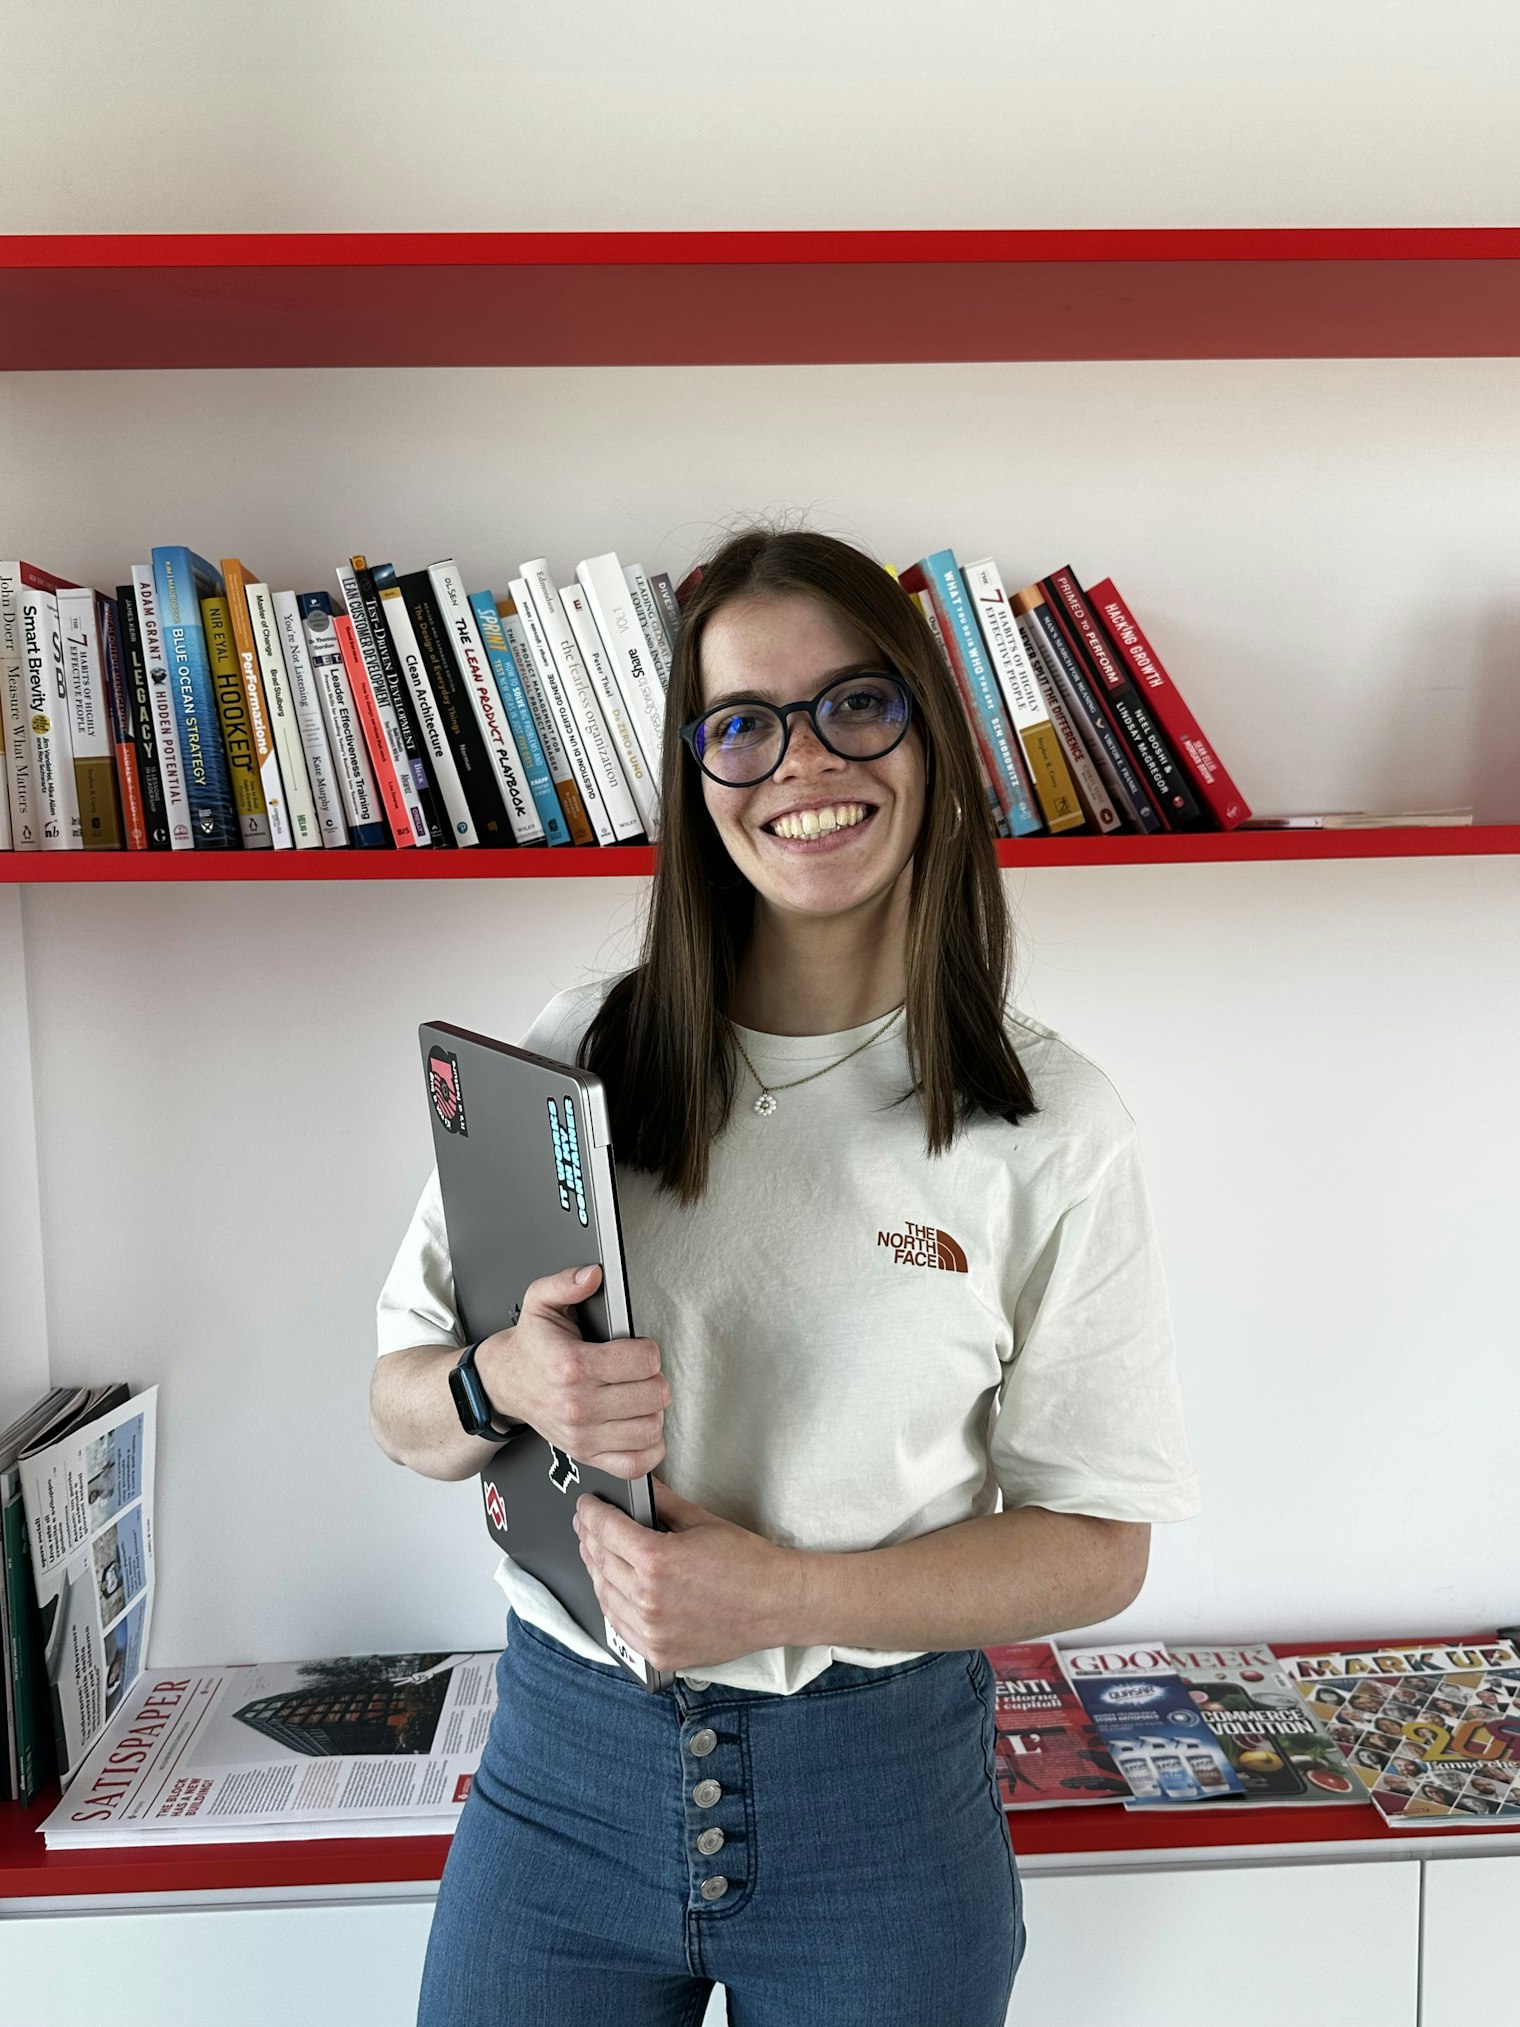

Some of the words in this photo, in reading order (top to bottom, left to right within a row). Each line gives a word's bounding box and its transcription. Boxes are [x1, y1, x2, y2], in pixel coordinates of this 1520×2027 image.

[0, 576, 13, 607] John
[342, 577, 359, 600] LEAN
[444, 577, 458, 606] OLSEN
[536, 571, 554, 613] Edmondson
[980, 571, 988, 584] THE
[125, 599, 133, 621] JAMES
[140, 582, 154, 616] ADAM
[414, 604, 423, 621] The
[635, 576, 655, 619] LEADING
[979, 588, 1004, 609] 7
[3, 613, 15, 650] Doerr
[23, 606, 40, 653] Smart
[128, 623, 136, 642] KERR
[209, 608, 222, 628] NIR
[256, 595, 265, 619] Master
[262, 628, 272, 657] Change
[283, 613, 295, 642] You're
[349, 601, 373, 647] CUSTOMER
[477, 609, 506, 650] SPRINT
[1058, 577, 1084, 618] PRIMED
[1086, 632, 1118, 682] PERFORM
[67, 633, 87, 648] 7
[145, 620, 161, 660] GRANT
[172, 628, 187, 662] BLUE
[213, 632, 228, 662] EYAL
[290, 645, 301, 663] Not
[419, 622, 433, 652] Design
[944, 571, 962, 604] WHAT
[956, 606, 967, 624] YOU
[968, 647, 984, 674] WHO
[979, 675, 989, 692] YOU
[984, 694, 994, 709] ARE
[1105, 603, 1137, 644] HACKING
[1130, 645, 1162, 687] GROWTH
[70, 646, 81, 696] EFFECTIVE
[80, 651, 89, 685] HABITS
[429, 653, 438, 663] of
[494, 659, 504, 677] TEST
[505, 662, 515, 677] HOW
[592, 652, 603, 674] Peter
[601, 675, 613, 697] Thiel
[985, 606, 1011, 664] EFFECTIVE
[1006, 669, 1026, 710] PEOPLE
[998, 611, 1017, 652] HABITS
[1013, 654, 1023, 667] OF
[1018, 670, 1038, 711] HIGHLY
[8, 666, 20, 719] Measure
[28, 658, 45, 711] Brevity
[84, 688, 91, 700] OF
[178, 666, 195, 713] OCEAN
[270, 669, 280, 686] Brad
[294, 665, 308, 707] Listening
[363, 648, 390, 707] DEVELOPMENT
[433, 665, 450, 704] Everyday
[499, 677, 509, 693] NEW
[510, 677, 518, 687] TO
[547, 673, 563, 706] GENERE
[1015, 627, 1036, 659] NEVER
[1031, 659, 1050, 685] SPLIT
[1044, 686, 1058, 705] THE
[1052, 706, 1084, 761] DIFFERENCE
[156, 691, 171, 734] HIDDEN
[242, 652, 267, 754] PerFormazione
[273, 686, 284, 717] Stulberg
[406, 654, 421, 686] Clean
[416, 689, 443, 757] Architecture
[504, 692, 515, 711] IDEAS
[507, 628, 516, 644] THE
[512, 646, 532, 694] UNOFFICIAL
[529, 696, 545, 730] PROJECT
[542, 733, 558, 771] MANAGER
[512, 686, 525, 708] SOLVE
[519, 643, 535, 677] PROJECT
[532, 680, 554, 734] MANAGEMENT
[550, 736, 560, 753] FOR
[519, 708, 529, 720] BIG
[560, 640, 575, 660] the
[568, 663, 590, 708] fearless
[585, 711, 618, 787] organization
[75, 699, 85, 732] PEOPLE
[85, 702, 95, 736] HIGHLY
[218, 674, 251, 768] HOOKED
[447, 705, 460, 734] Things
[455, 618, 471, 644] THE
[464, 648, 483, 682] LEAN
[477, 687, 504, 744] PRODUCT
[497, 749, 525, 816] PLAYBOOK
[509, 711, 518, 719] IN
[512, 720, 523, 735] JUST
[559, 707, 573, 734] CERTO
[13, 725, 26, 759] What
[186, 717, 205, 786] STRATEGY
[330, 668, 344, 704] Leader
[339, 708, 360, 777] Effectiveness
[355, 778, 370, 820] Training
[517, 735, 528, 752] FIVE
[523, 720, 538, 752] PROBLEMS
[568, 734, 577, 744] UN
[571, 743, 579, 752] DI
[991, 717, 1003, 737] BEN
[998, 739, 1019, 786] HOROWITZ
[1116, 702, 1141, 740] LINDSAY
[1138, 742, 1168, 793] McGREGOR
[1134, 709, 1151, 734] NEEL
[1148, 734, 1167, 764] DOSHI
[1163, 765, 1172, 773] &
[163, 739, 181, 804] POTENTIAL
[312, 756, 323, 775] Kate
[522, 751, 533, 769] DAYS
[533, 753, 543, 766] AND
[16, 765, 29, 813] Matters
[316, 778, 329, 811] Murphy
[576, 757, 596, 799] QUESTIONI
[547, 1100, 564, 1181] WORKS
[559, 1128, 572, 1162] MY
[564, 1098, 588, 1226] CONTAINER
[564, 1164, 576, 1189] IN
[559, 1184, 570, 1210] IT
[877, 1231, 936, 1254] NORTH
[905, 1221, 935, 1241] THE
[894, 1249, 937, 1268] FACE
[1296, 1652, 1445, 1679] MARK
[1446, 1648, 1513, 1668] UP
[1004, 1694, 1057, 1702] ritorna
[1004, 1701, 1062, 1710] capitali
[72, 1678, 191, 1822] SATISPAPER
[155, 1802, 173, 1817] THE
[165, 1778, 188, 1802] BLOCK
[170, 1802, 187, 1816] HAS
[184, 1777, 202, 1794] NEW
